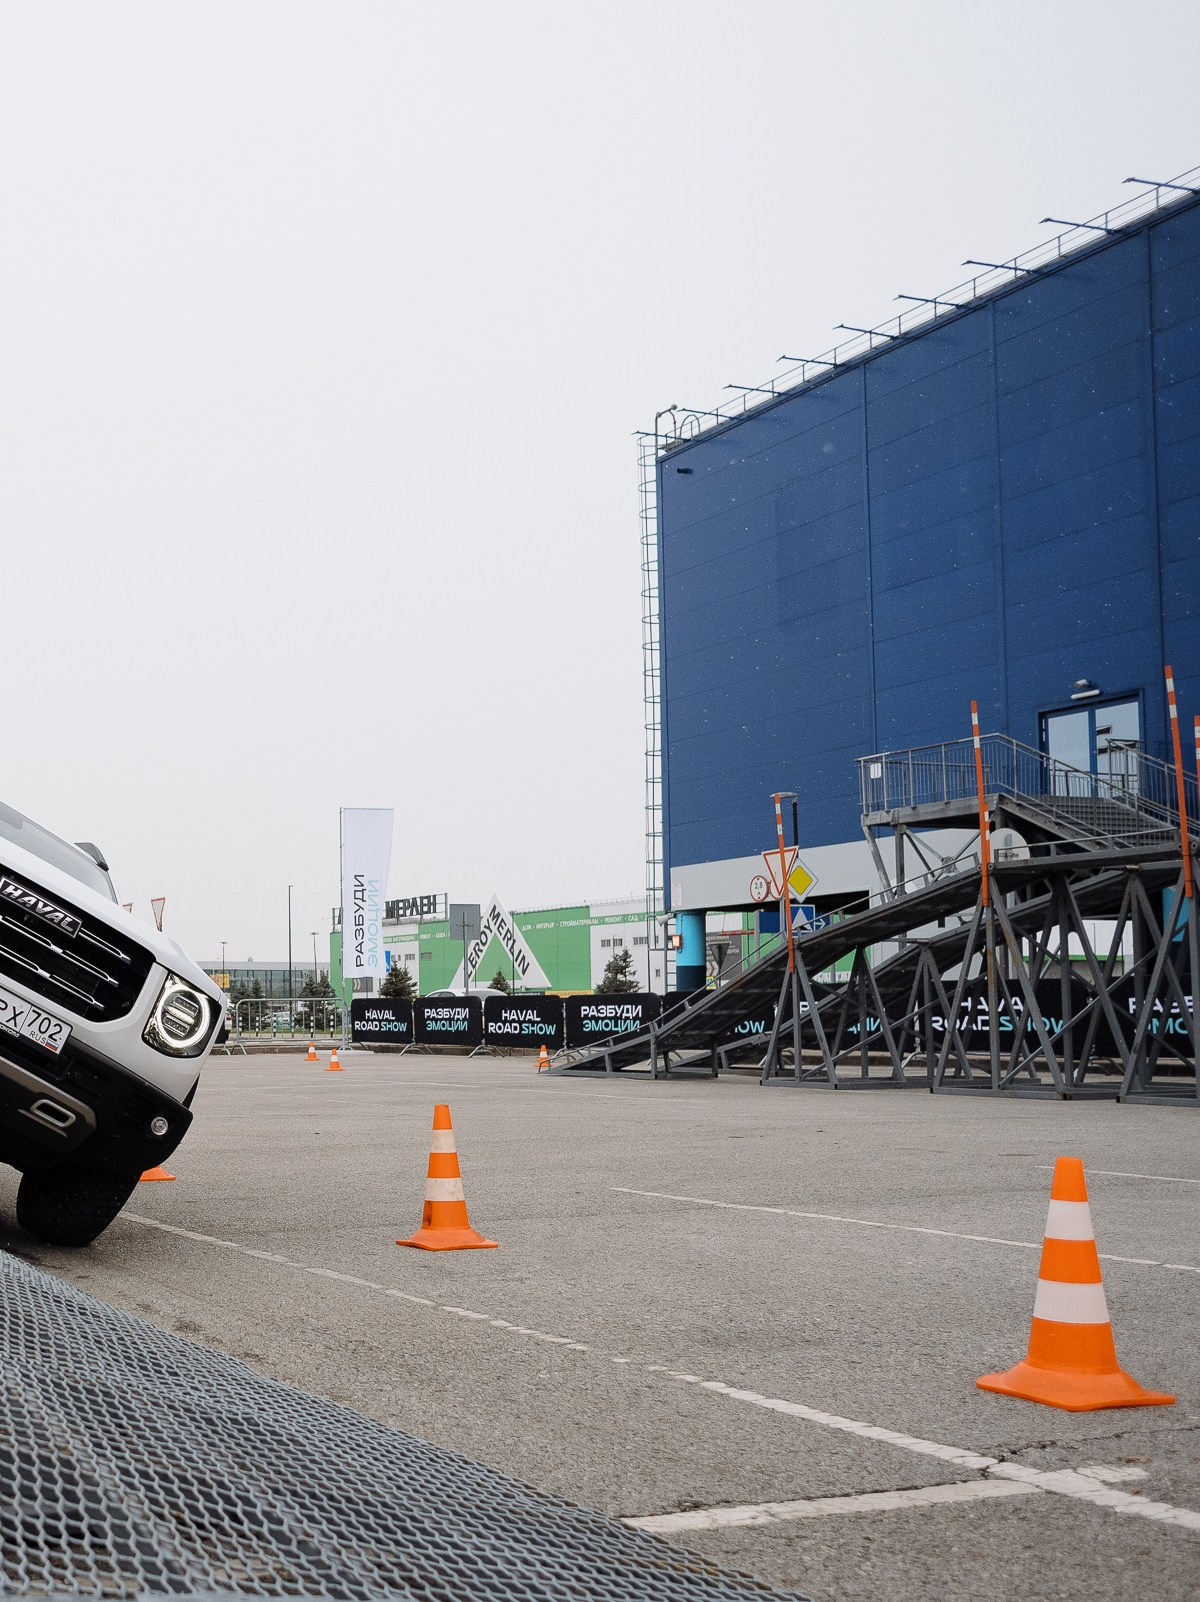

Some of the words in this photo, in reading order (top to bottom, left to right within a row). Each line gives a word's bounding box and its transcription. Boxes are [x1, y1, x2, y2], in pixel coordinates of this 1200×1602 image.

[2, 884, 73, 932] HAVAL
[385, 894, 437, 919] МЕРЛЕН
[353, 874, 366, 968] РАЗБУДИ
[367, 879, 379, 968] ЭМОЦИИ
[489, 904, 530, 976] MERLIN
[365, 1009, 395, 1020] HAVAL
[424, 1007, 469, 1020] РАЗБУДИ
[501, 1009, 541, 1021] HAVAL
[580, 1004, 642, 1019] РАЗБУДИ
[26, 1009, 63, 1043] 702
[354, 1020, 379, 1031] ROAD
[380, 1021, 407, 1032] SHOW
[426, 1020, 468, 1032] ЭМОЦИИ
[488, 1022, 519, 1034] ROAD
[521, 1023, 556, 1035] SHOW
[582, 1019, 640, 1033] ЭМОЦИИ
[29, 1030, 47, 1044] RUS
